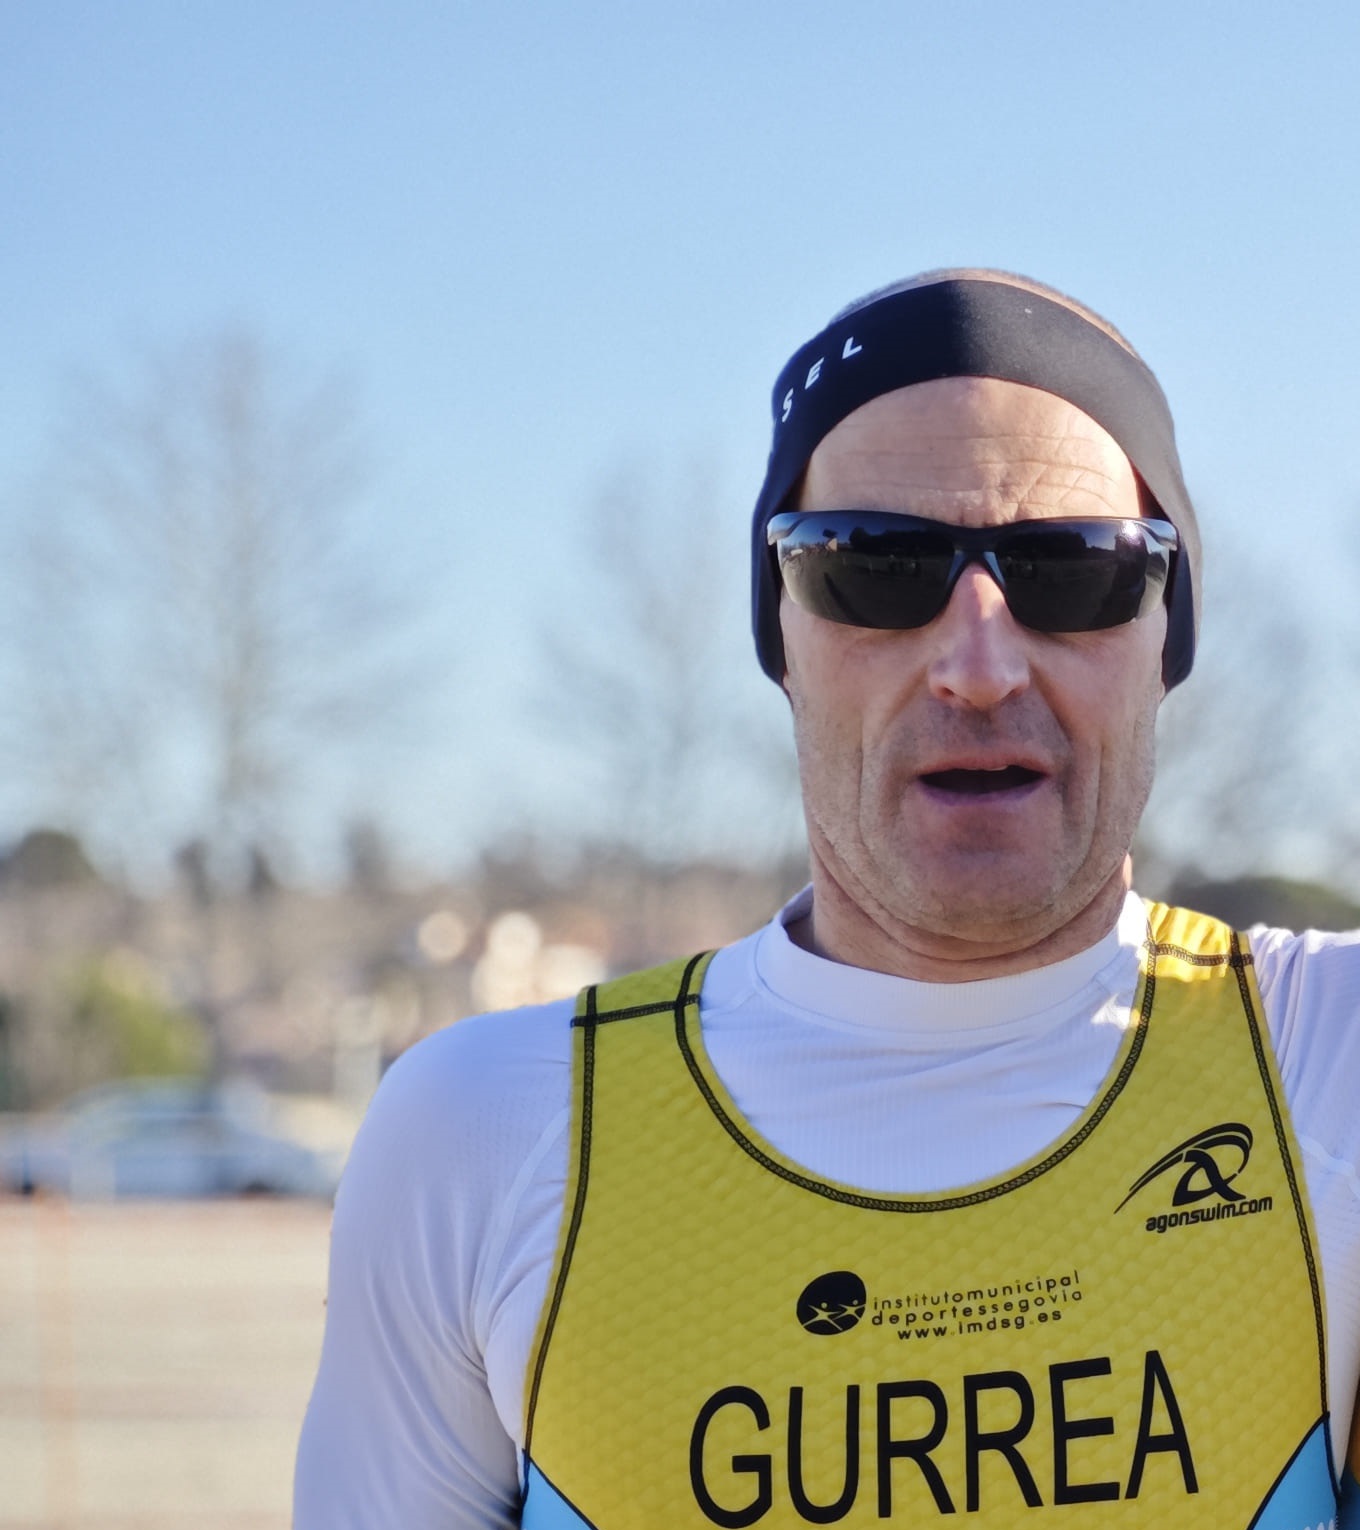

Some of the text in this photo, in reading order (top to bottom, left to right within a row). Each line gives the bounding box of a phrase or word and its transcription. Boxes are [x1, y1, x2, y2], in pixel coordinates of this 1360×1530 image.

[1146, 1196, 1273, 1233] agonswim.com
[871, 1289, 1083, 1326] deportessegovia
[873, 1270, 1081, 1311] institutomunicipal
[897, 1309, 1062, 1340] www.imdsg.es
[689, 1349, 1199, 1530] GURREA
